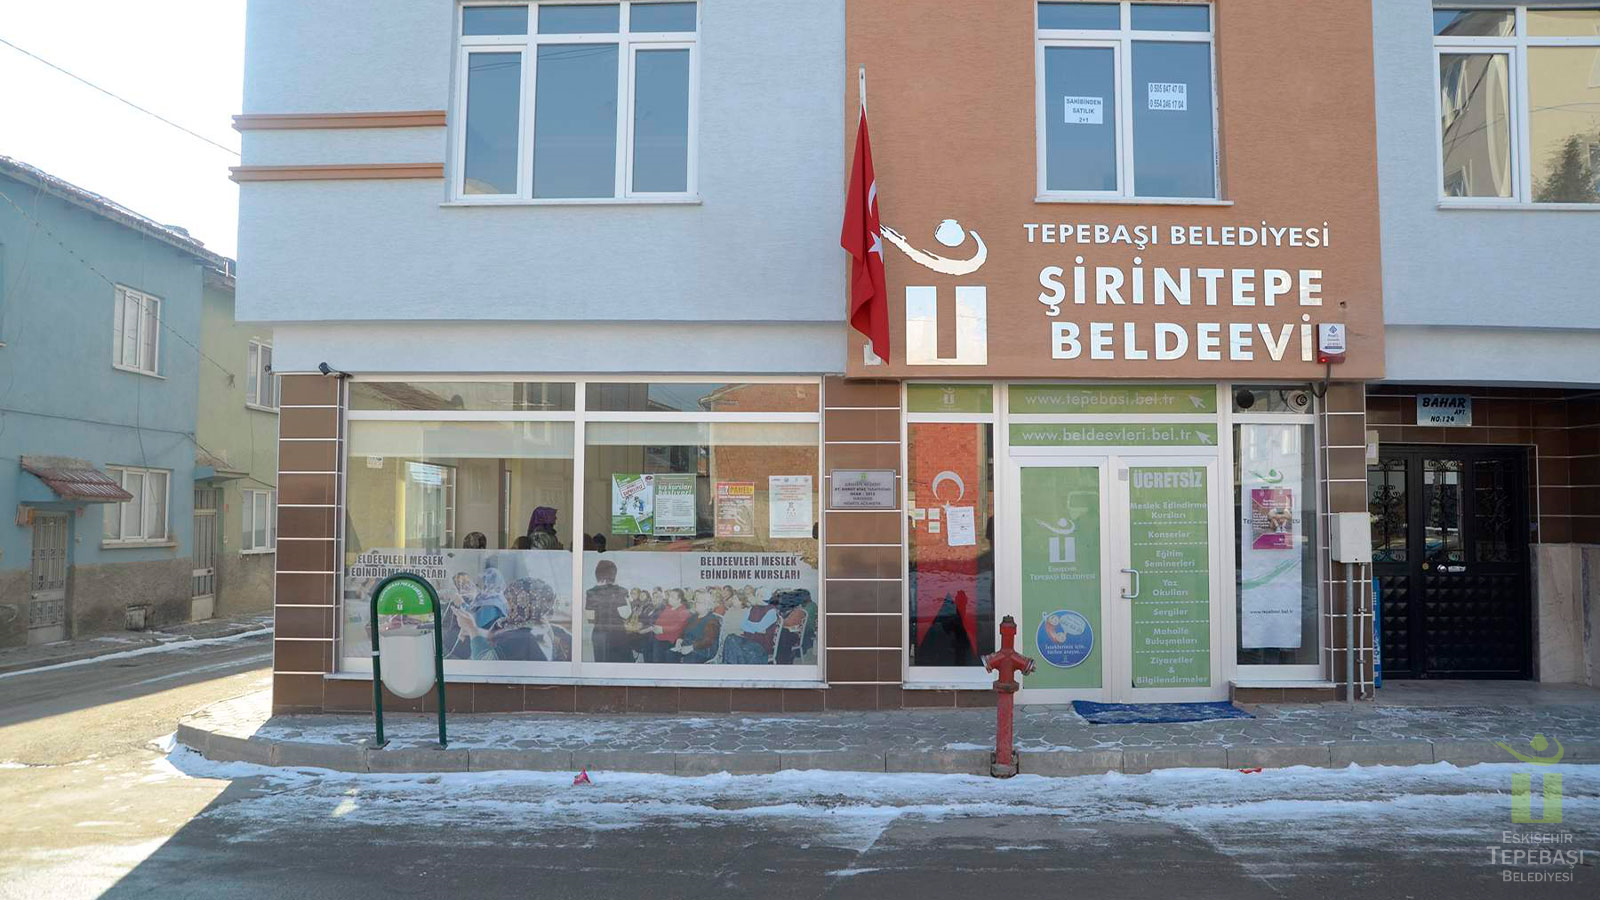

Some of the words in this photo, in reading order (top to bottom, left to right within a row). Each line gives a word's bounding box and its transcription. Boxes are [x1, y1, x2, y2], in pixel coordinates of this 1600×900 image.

[1023, 223, 1158, 250] TEPEBAŞI
[1170, 220, 1329, 248] BELEDİYESİ
[1038, 255, 1323, 317] ŞİRİNTEPE
[1051, 313, 1313, 362] BELDEEVİ
[1024, 391, 1175, 408] www.tepebasi.bel.tr
[1422, 397, 1466, 408] BAHAR
[1022, 427, 1191, 441] www.beldeevleri.bel.tr
[1133, 468, 1203, 489] ÜCRETSİZ
[1130, 501, 1161, 511] Meslek
[1151, 511, 1186, 519] Kursları
[1148, 530, 1191, 538] Konserler
[1156, 549, 1183, 559] Eğitim
[410, 555, 444, 566] MESLEK
[700, 555, 759, 567] BELDEEVLERİ
[761, 556, 797, 567] MESLEK
[1144, 560, 1196, 568] Seminerleri
[700, 568, 752, 580] EDİNDİRME
[754, 569, 801, 580] KURSLARI
[1152, 588, 1189, 596] Okulları
[1152, 608, 1188, 617] Sergiler
[1152, 628, 1189, 636] Mahalle
[1145, 638, 1198, 647] Buluşmaları
[1151, 657, 1194, 666] Ziyaretler
[1137, 676, 1209, 685] Bilgilendirmeler
